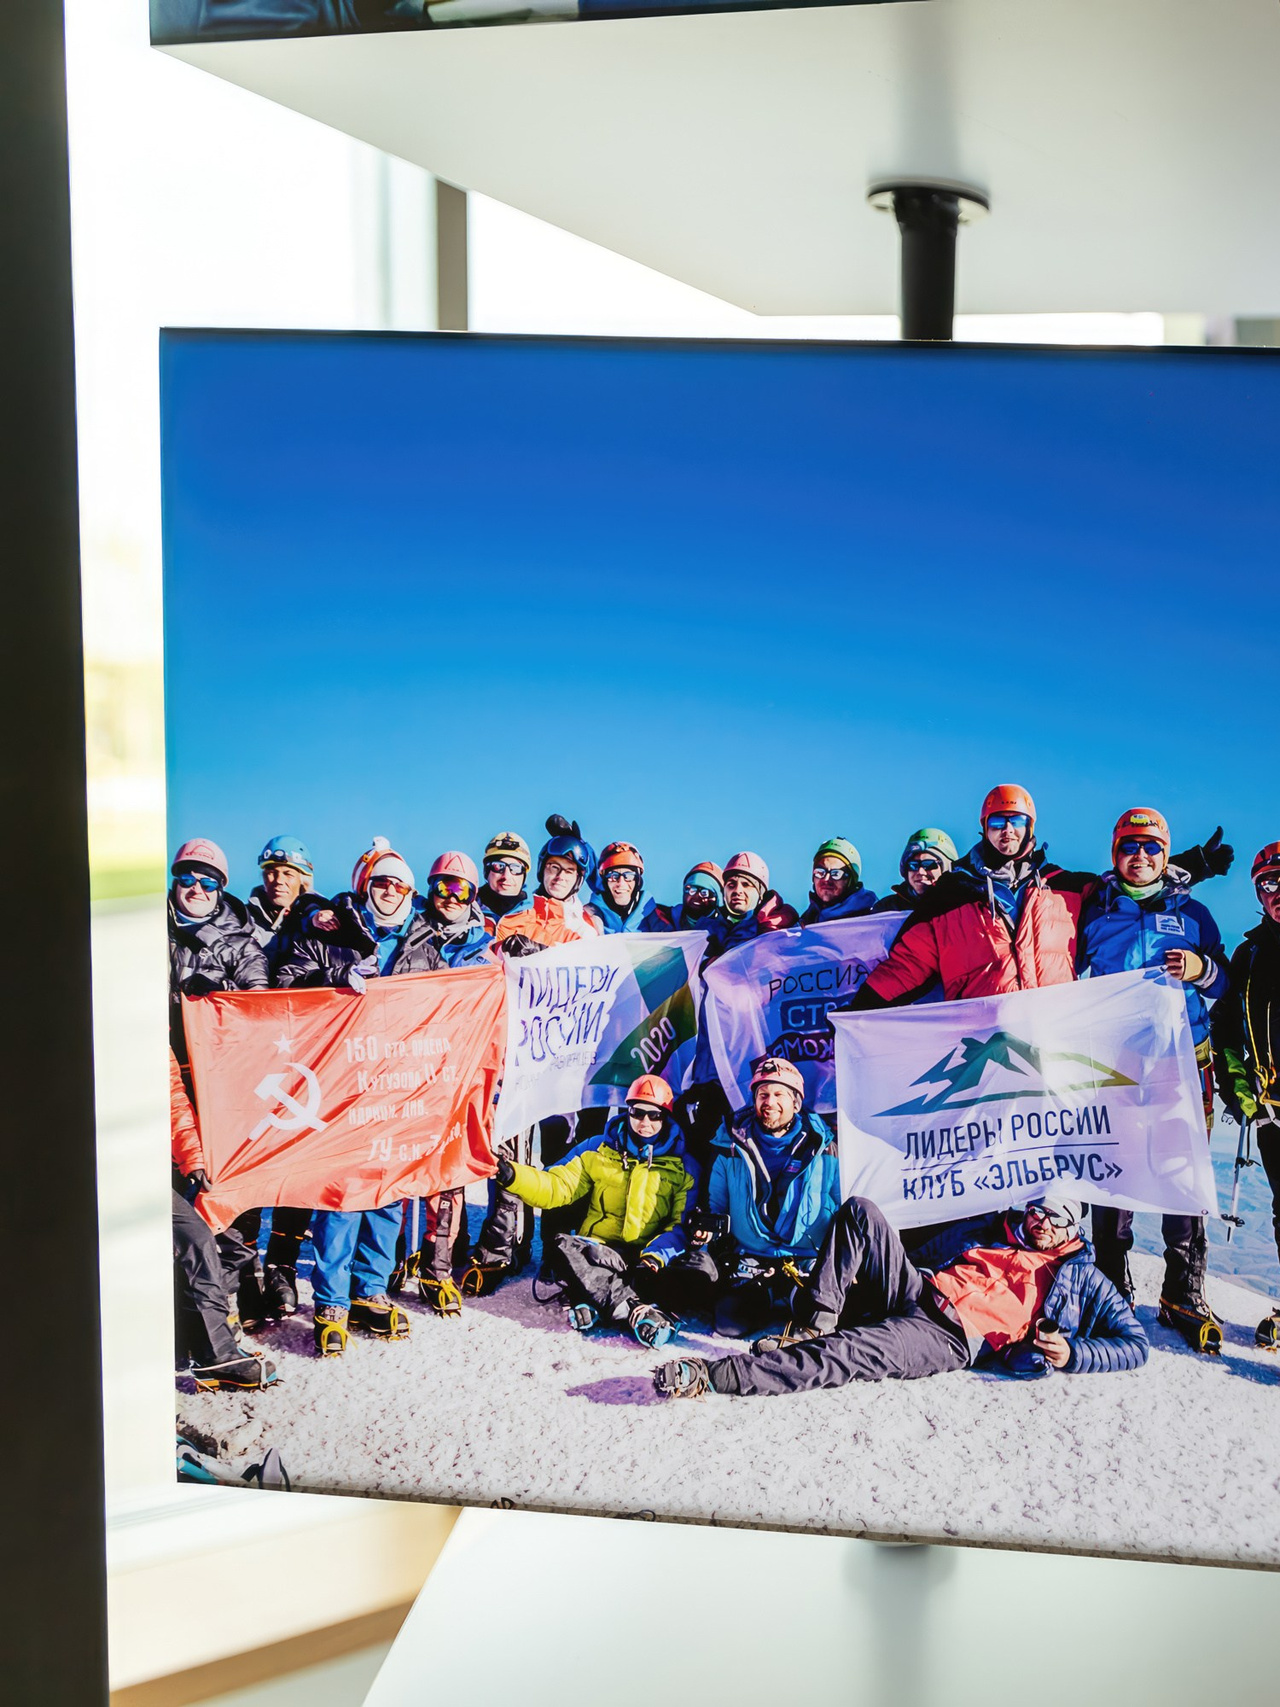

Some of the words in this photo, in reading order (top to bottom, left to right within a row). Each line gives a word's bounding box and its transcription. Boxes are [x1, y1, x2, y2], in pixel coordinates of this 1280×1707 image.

[769, 964, 869, 1001] РОССИЯ
[787, 1001, 852, 1028] СТР
[344, 1036, 378, 1063] 150
[630, 1016, 677, 1074] 2020
[904, 1118, 1002, 1160] ЛИДЕРЫ
[1011, 1105, 1111, 1141] РОССИИ
[902, 1170, 965, 1200] КЛУБ
[973, 1153, 1123, 1191] «ЭЛЬБРУС»
